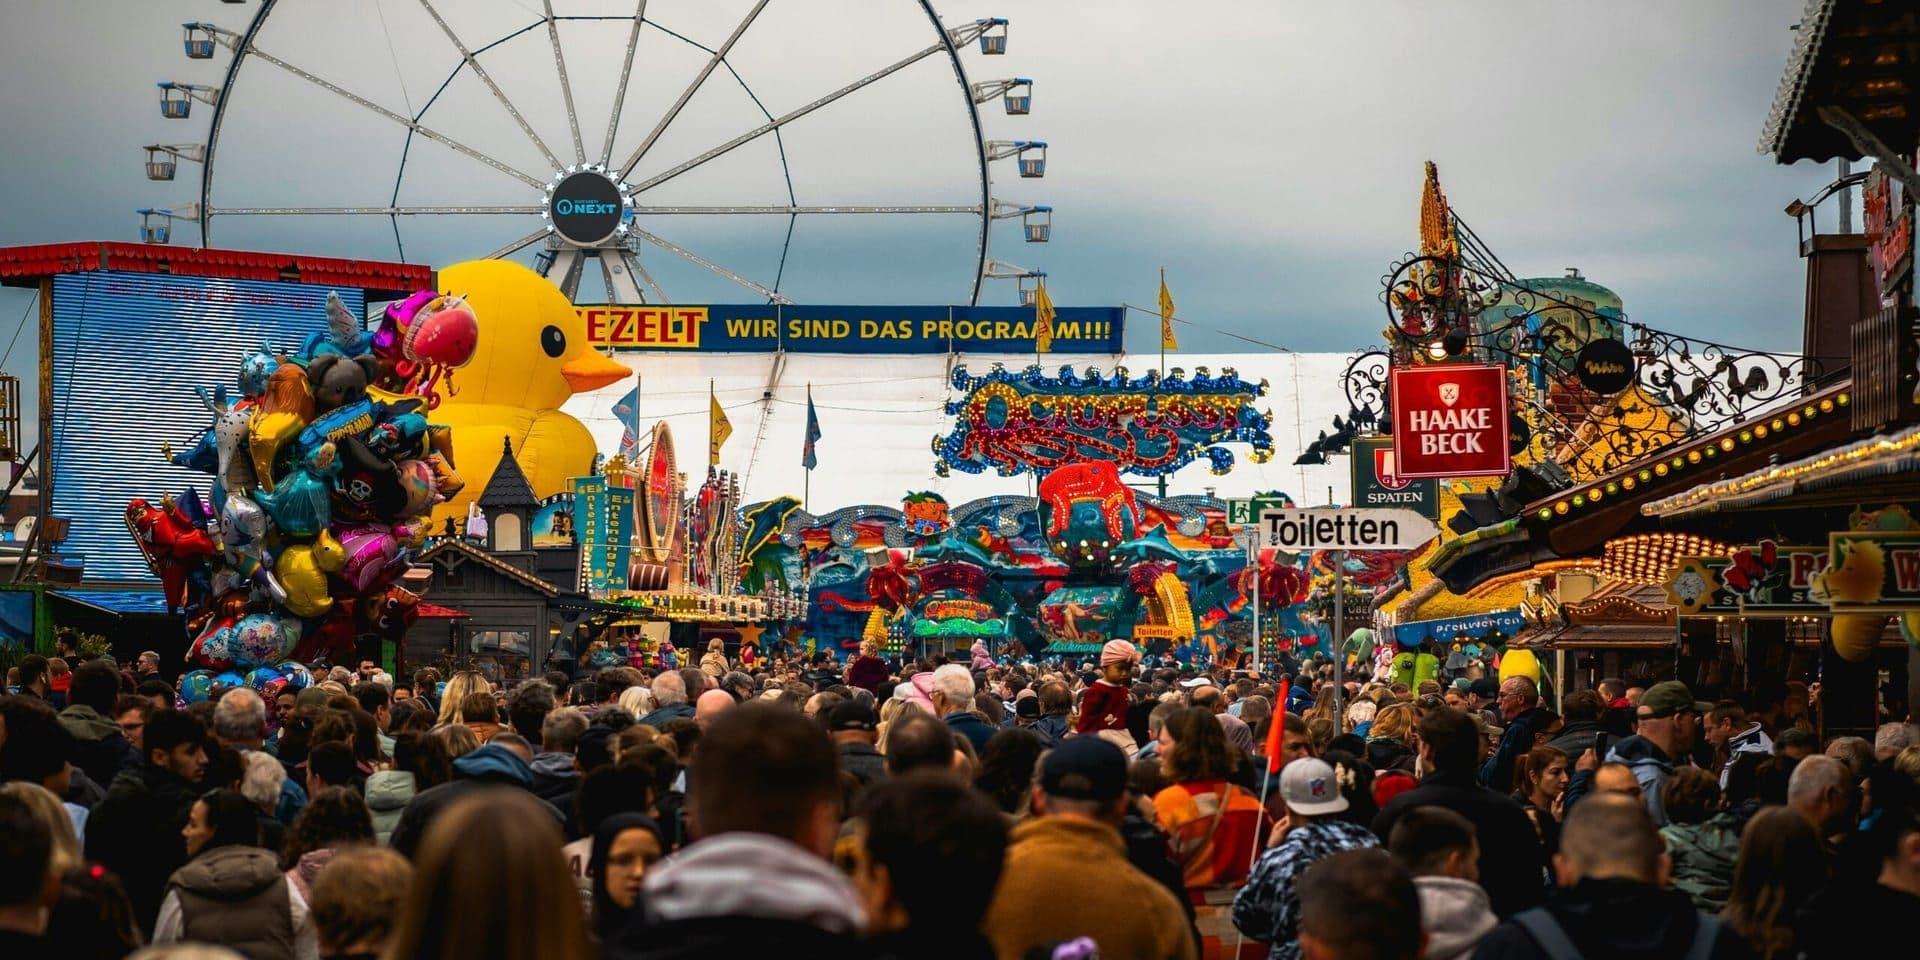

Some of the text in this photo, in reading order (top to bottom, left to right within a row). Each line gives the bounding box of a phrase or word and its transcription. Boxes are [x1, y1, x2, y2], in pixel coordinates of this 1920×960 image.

[574, 204, 617, 214] NEXT
[575, 310, 703, 343] EZELT
[725, 319, 778, 338] WIR
[788, 319, 850, 338] SIND
[860, 320, 913, 339] DAS
[1409, 407, 1493, 432] HAAKE
[1420, 432, 1485, 456] BECK
[1367, 491, 1423, 504] SPATEN
[1264, 513, 1399, 547] Toiletten
[1137, 628, 1173, 636] Toiletten
